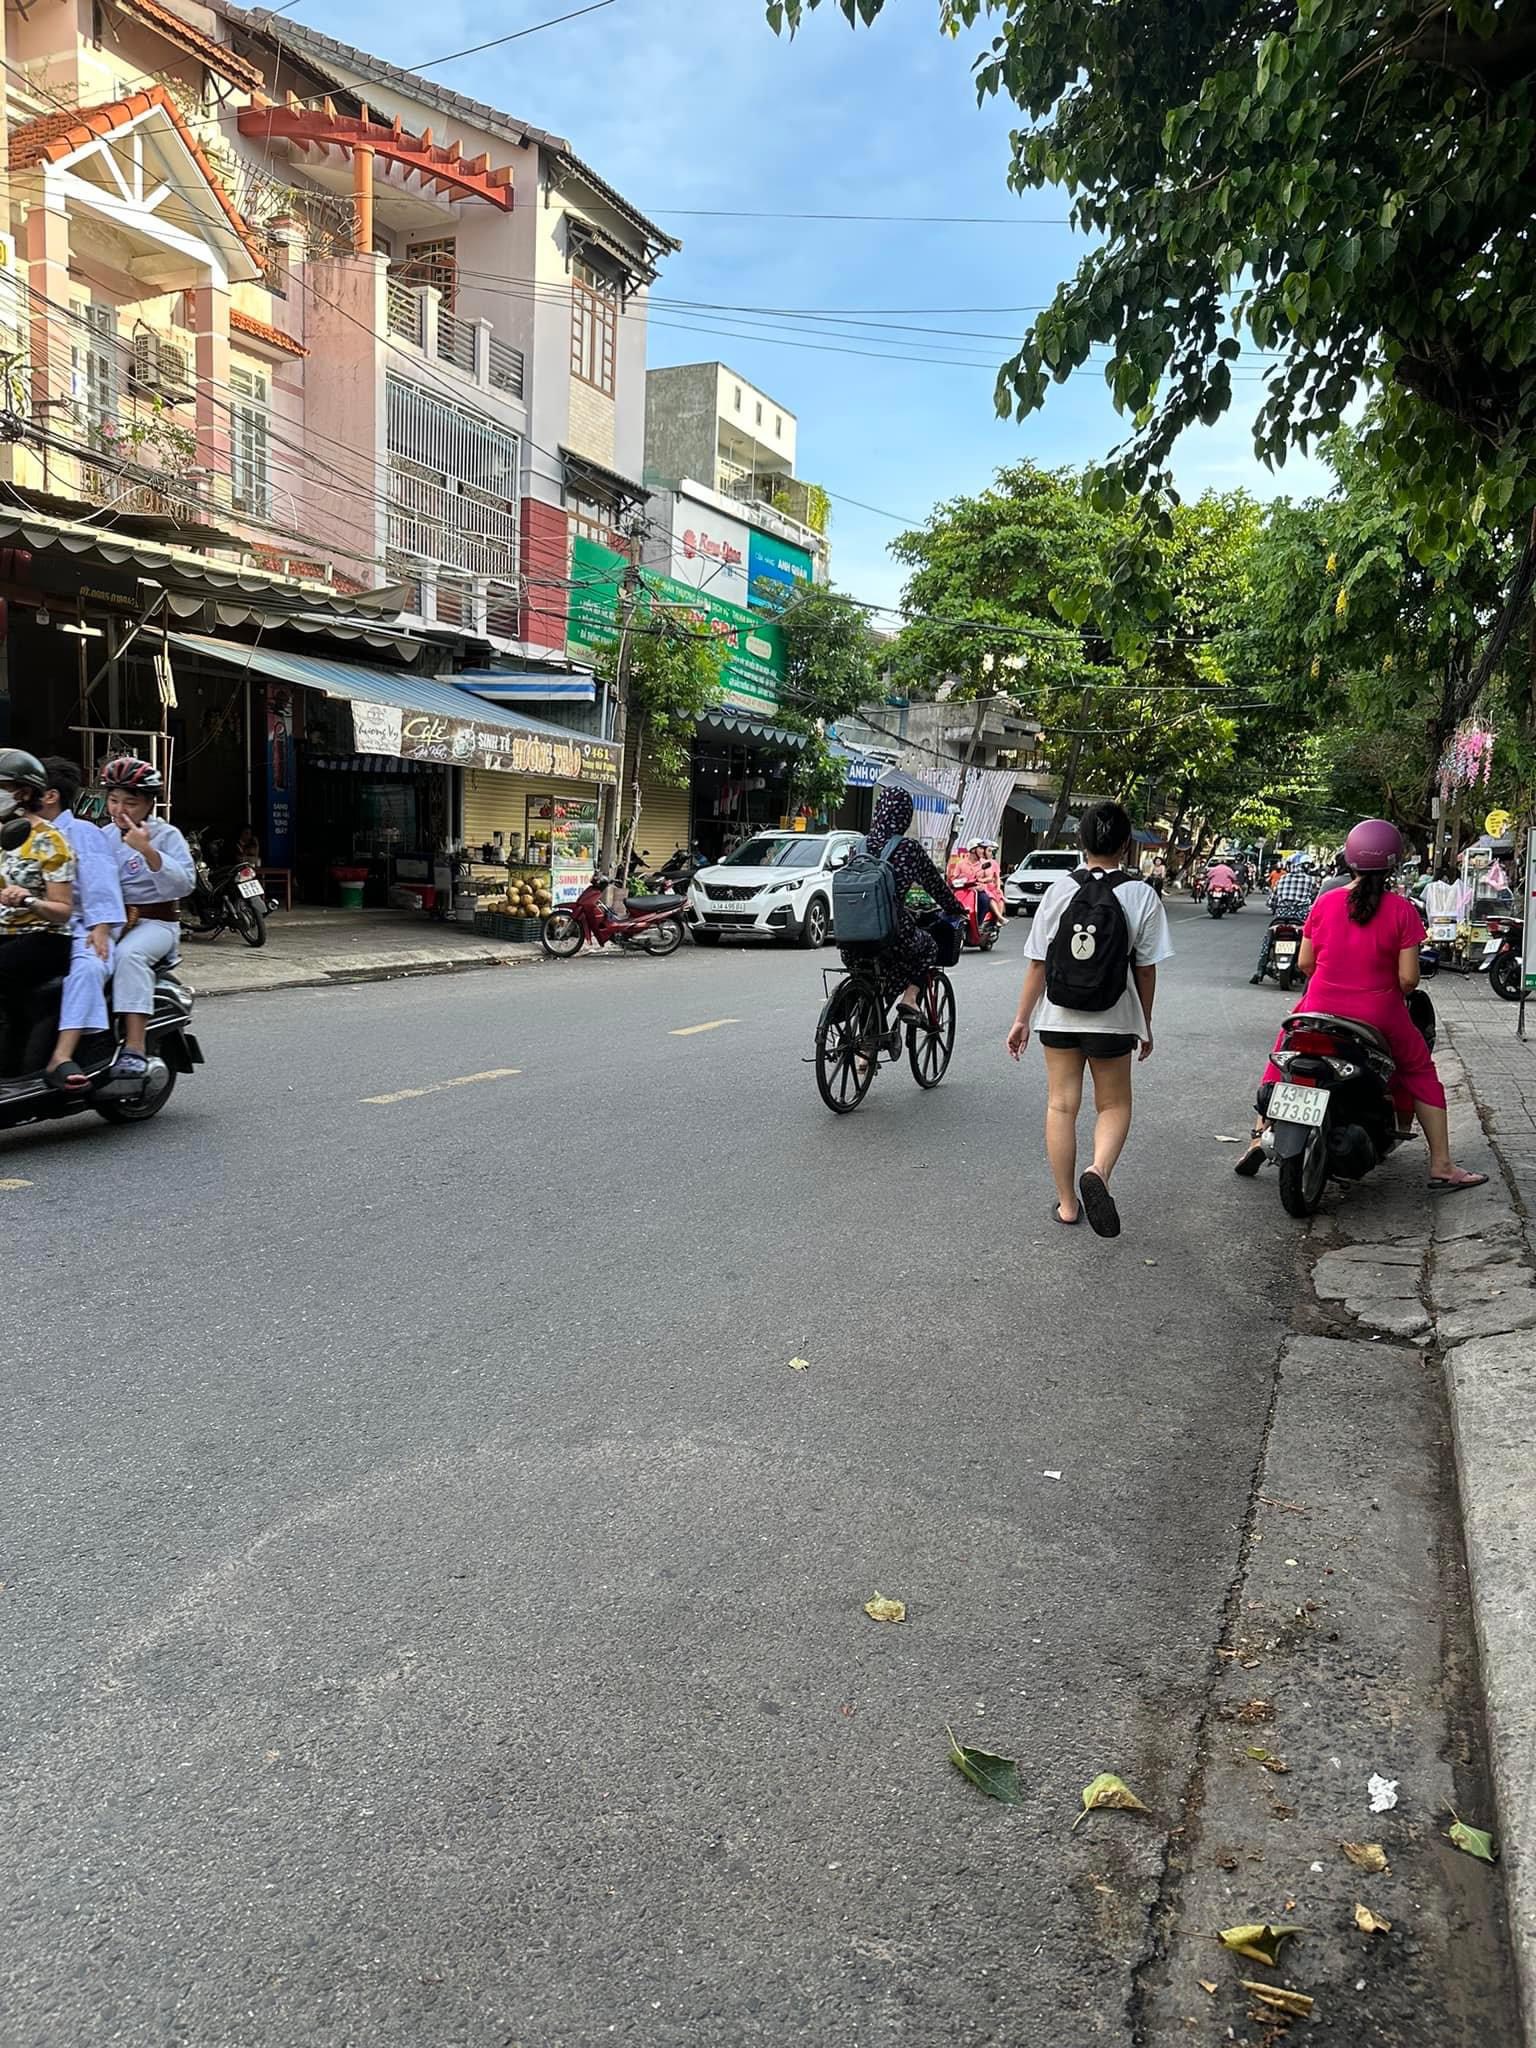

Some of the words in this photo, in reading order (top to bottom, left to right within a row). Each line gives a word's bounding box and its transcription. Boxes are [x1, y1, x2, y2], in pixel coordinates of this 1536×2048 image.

[478, 732, 498, 750] SINH
[592, 747, 610, 760] 461
[1281, 1086, 1320, 1106] 43-C1
[1271, 1101, 1321, 1124] 373.60
